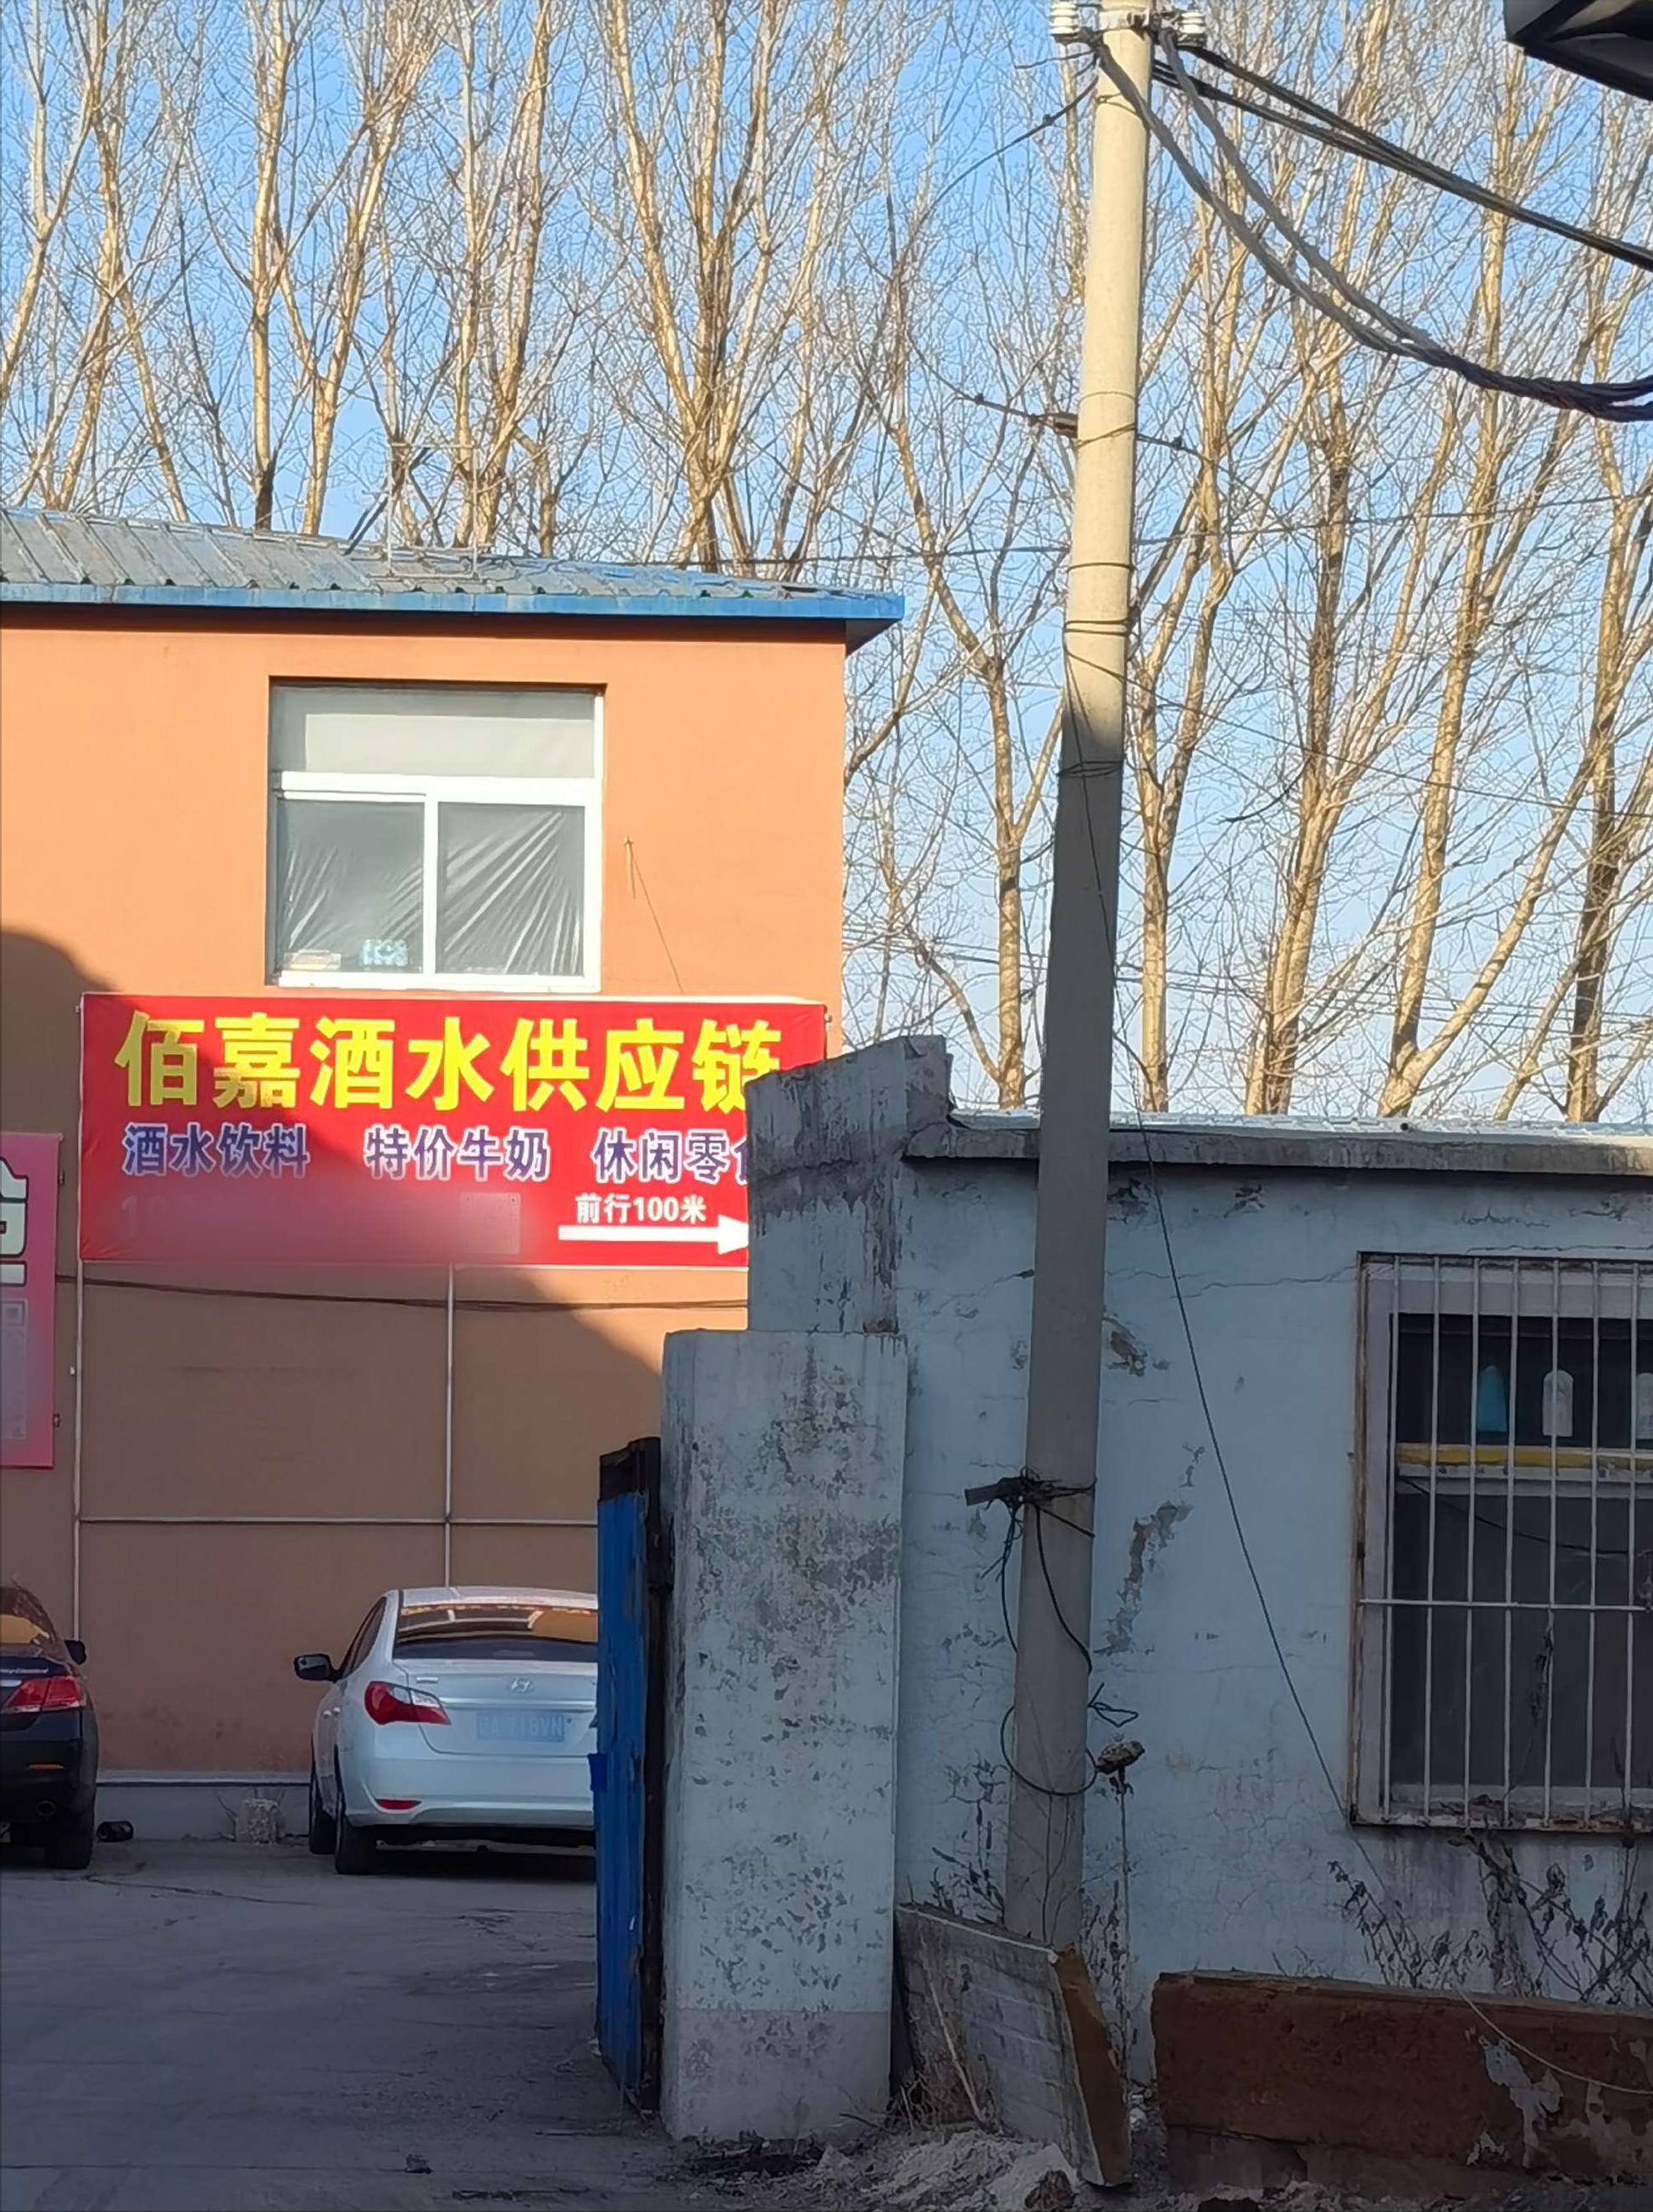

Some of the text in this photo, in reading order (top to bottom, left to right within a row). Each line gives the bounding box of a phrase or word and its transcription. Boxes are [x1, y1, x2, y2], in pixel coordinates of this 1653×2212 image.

[115, 1010, 781, 1114] 佰嘉酒水供应链
[122, 1122, 748, 1185] 酒水饮料 特价牛奶 休闲零
[574, 1193, 707, 1224] 前行100米
